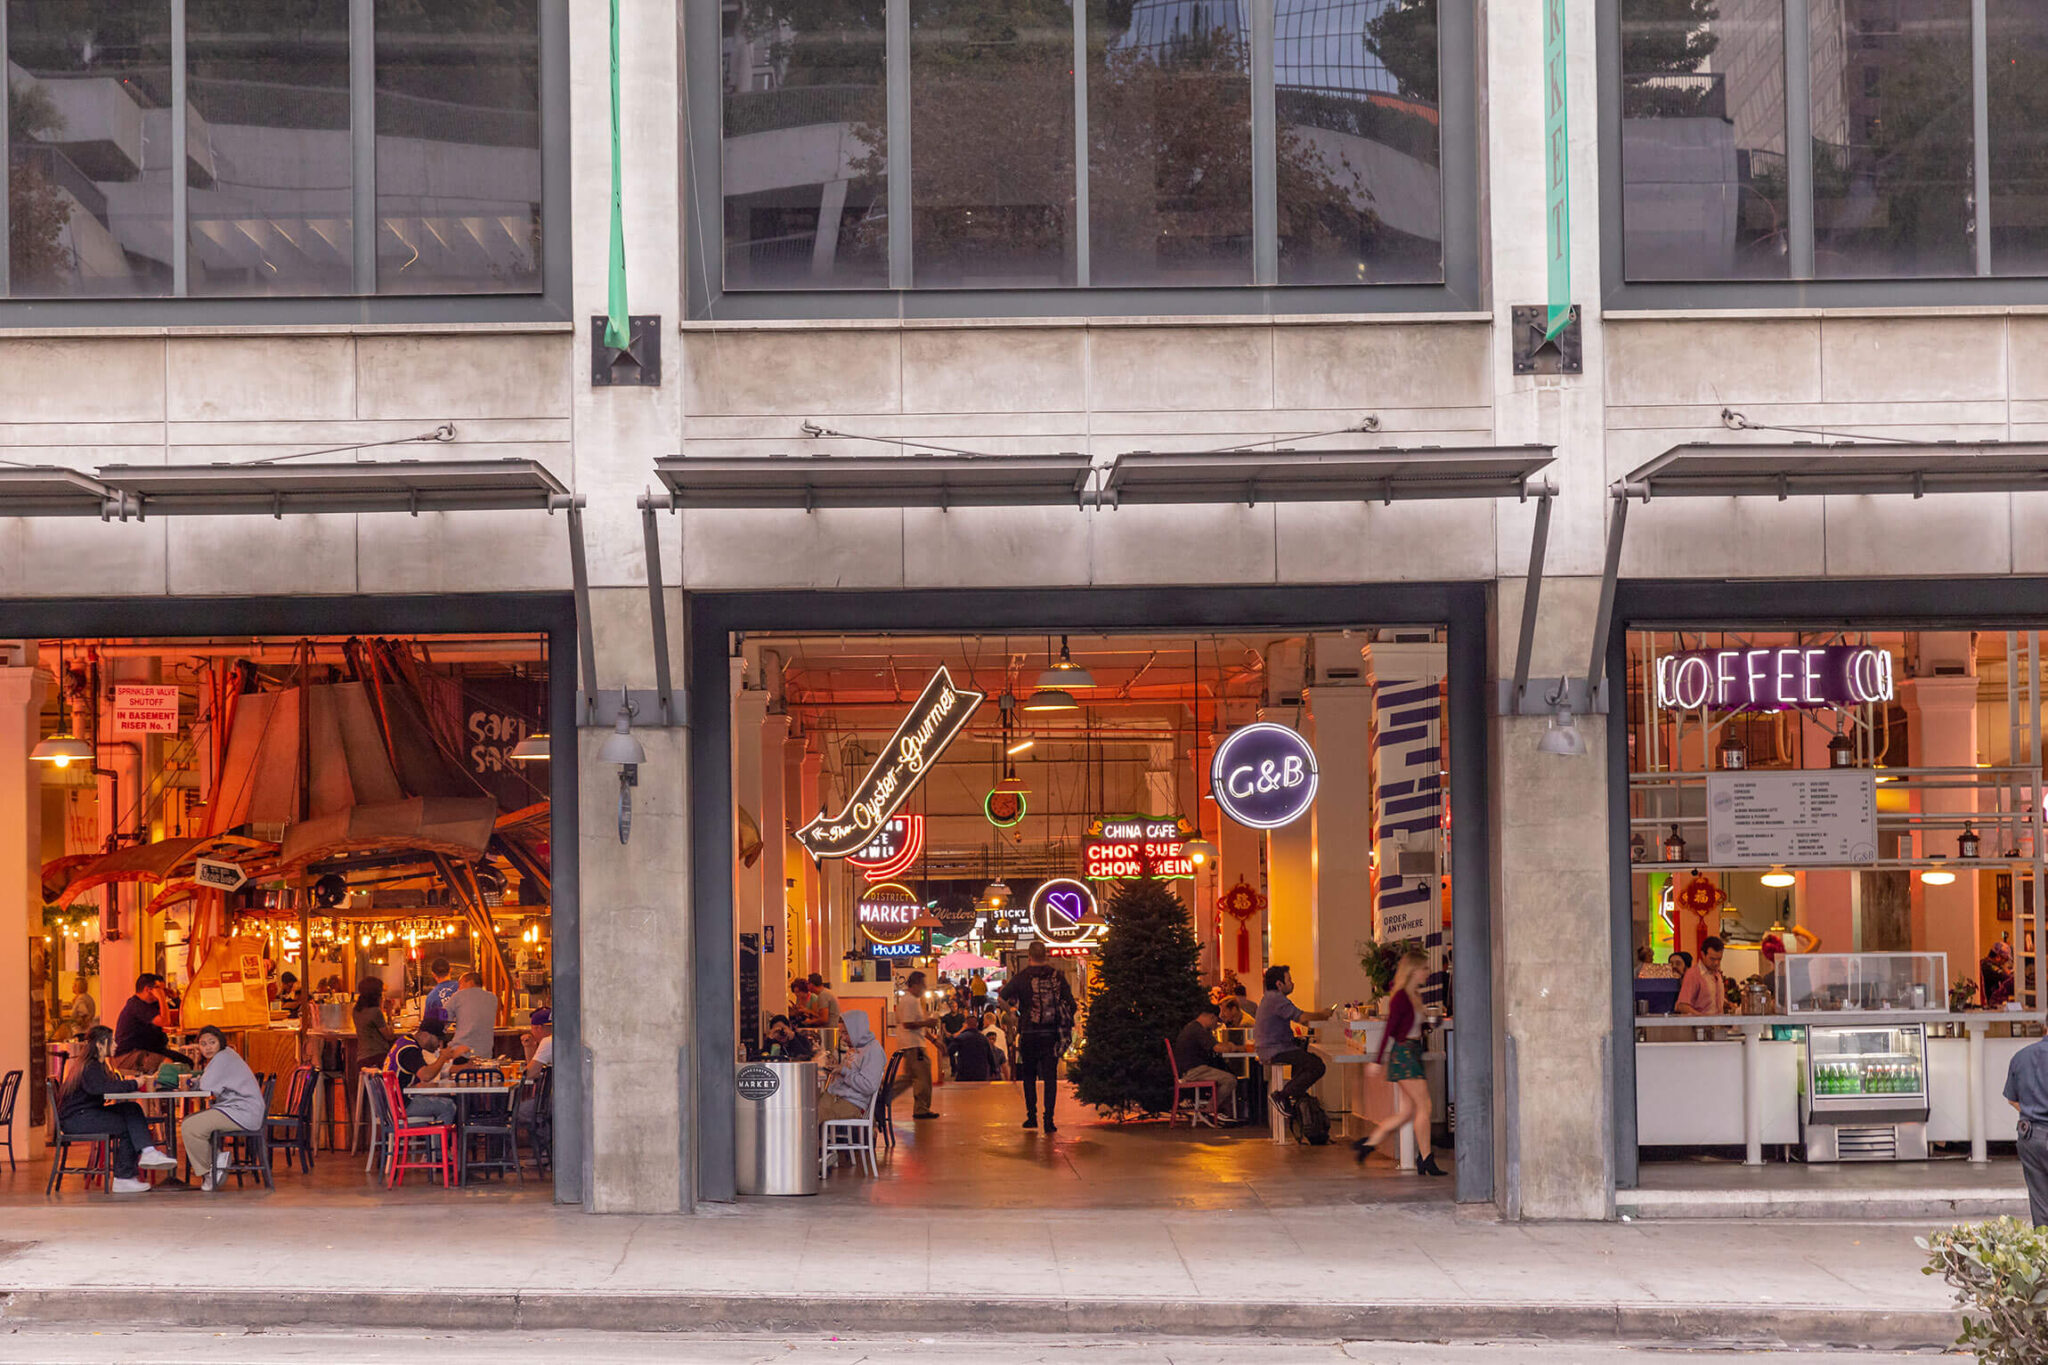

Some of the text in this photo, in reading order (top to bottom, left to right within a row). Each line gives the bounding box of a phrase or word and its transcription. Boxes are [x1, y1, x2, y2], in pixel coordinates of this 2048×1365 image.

[118, 688, 176, 697] SPRINKLER VALVE
[129, 698, 165, 706] SHUTOFF
[117, 711, 176, 720] IN BASEMENT
[121, 721, 172, 730] RISER No. 1
[853, 767, 899, 830] Oyster
[897, 686, 956, 773] Gourmet
[1228, 755, 1305, 799] G&B
[1104, 824, 1176, 839] CHINA CAFE
[1145, 843, 1184, 858] SUE
[1089, 861, 1141, 876] CHOW
[870, 892, 910, 902] DISTRICT
[860, 904, 920, 923] MARKET
[993, 909, 1027, 919] STICKY
[1384, 913, 1407, 926] ORDER
[1387, 919, 1424, 934] ANYWHERE
[1051, 947, 1090, 957] PIZZA
[738, 1080, 776, 1088] MARKET
